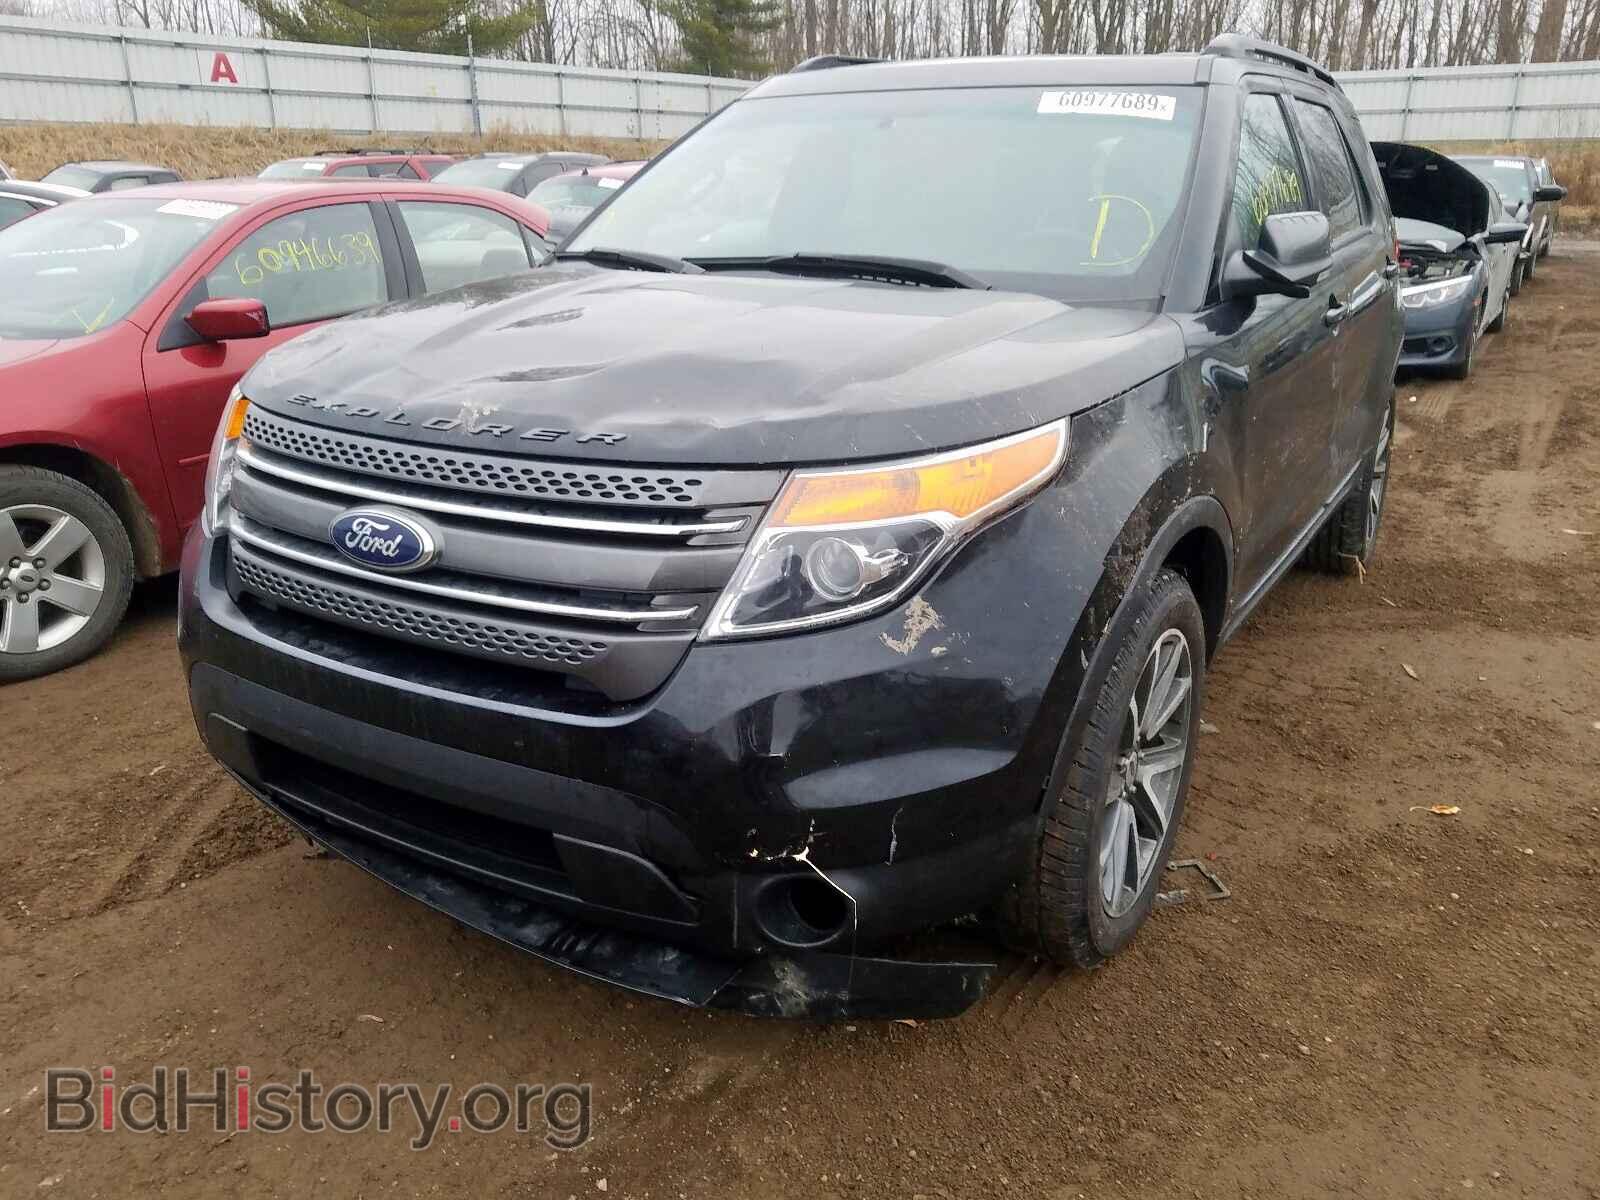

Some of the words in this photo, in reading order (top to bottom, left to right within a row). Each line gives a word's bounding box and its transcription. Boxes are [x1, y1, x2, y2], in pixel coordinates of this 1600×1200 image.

[210, 52, 238, 84] A
[1080, 194, 1155, 266] D
[286, 393, 628, 446] EXPLORER
[345, 517, 403, 558] Ford
